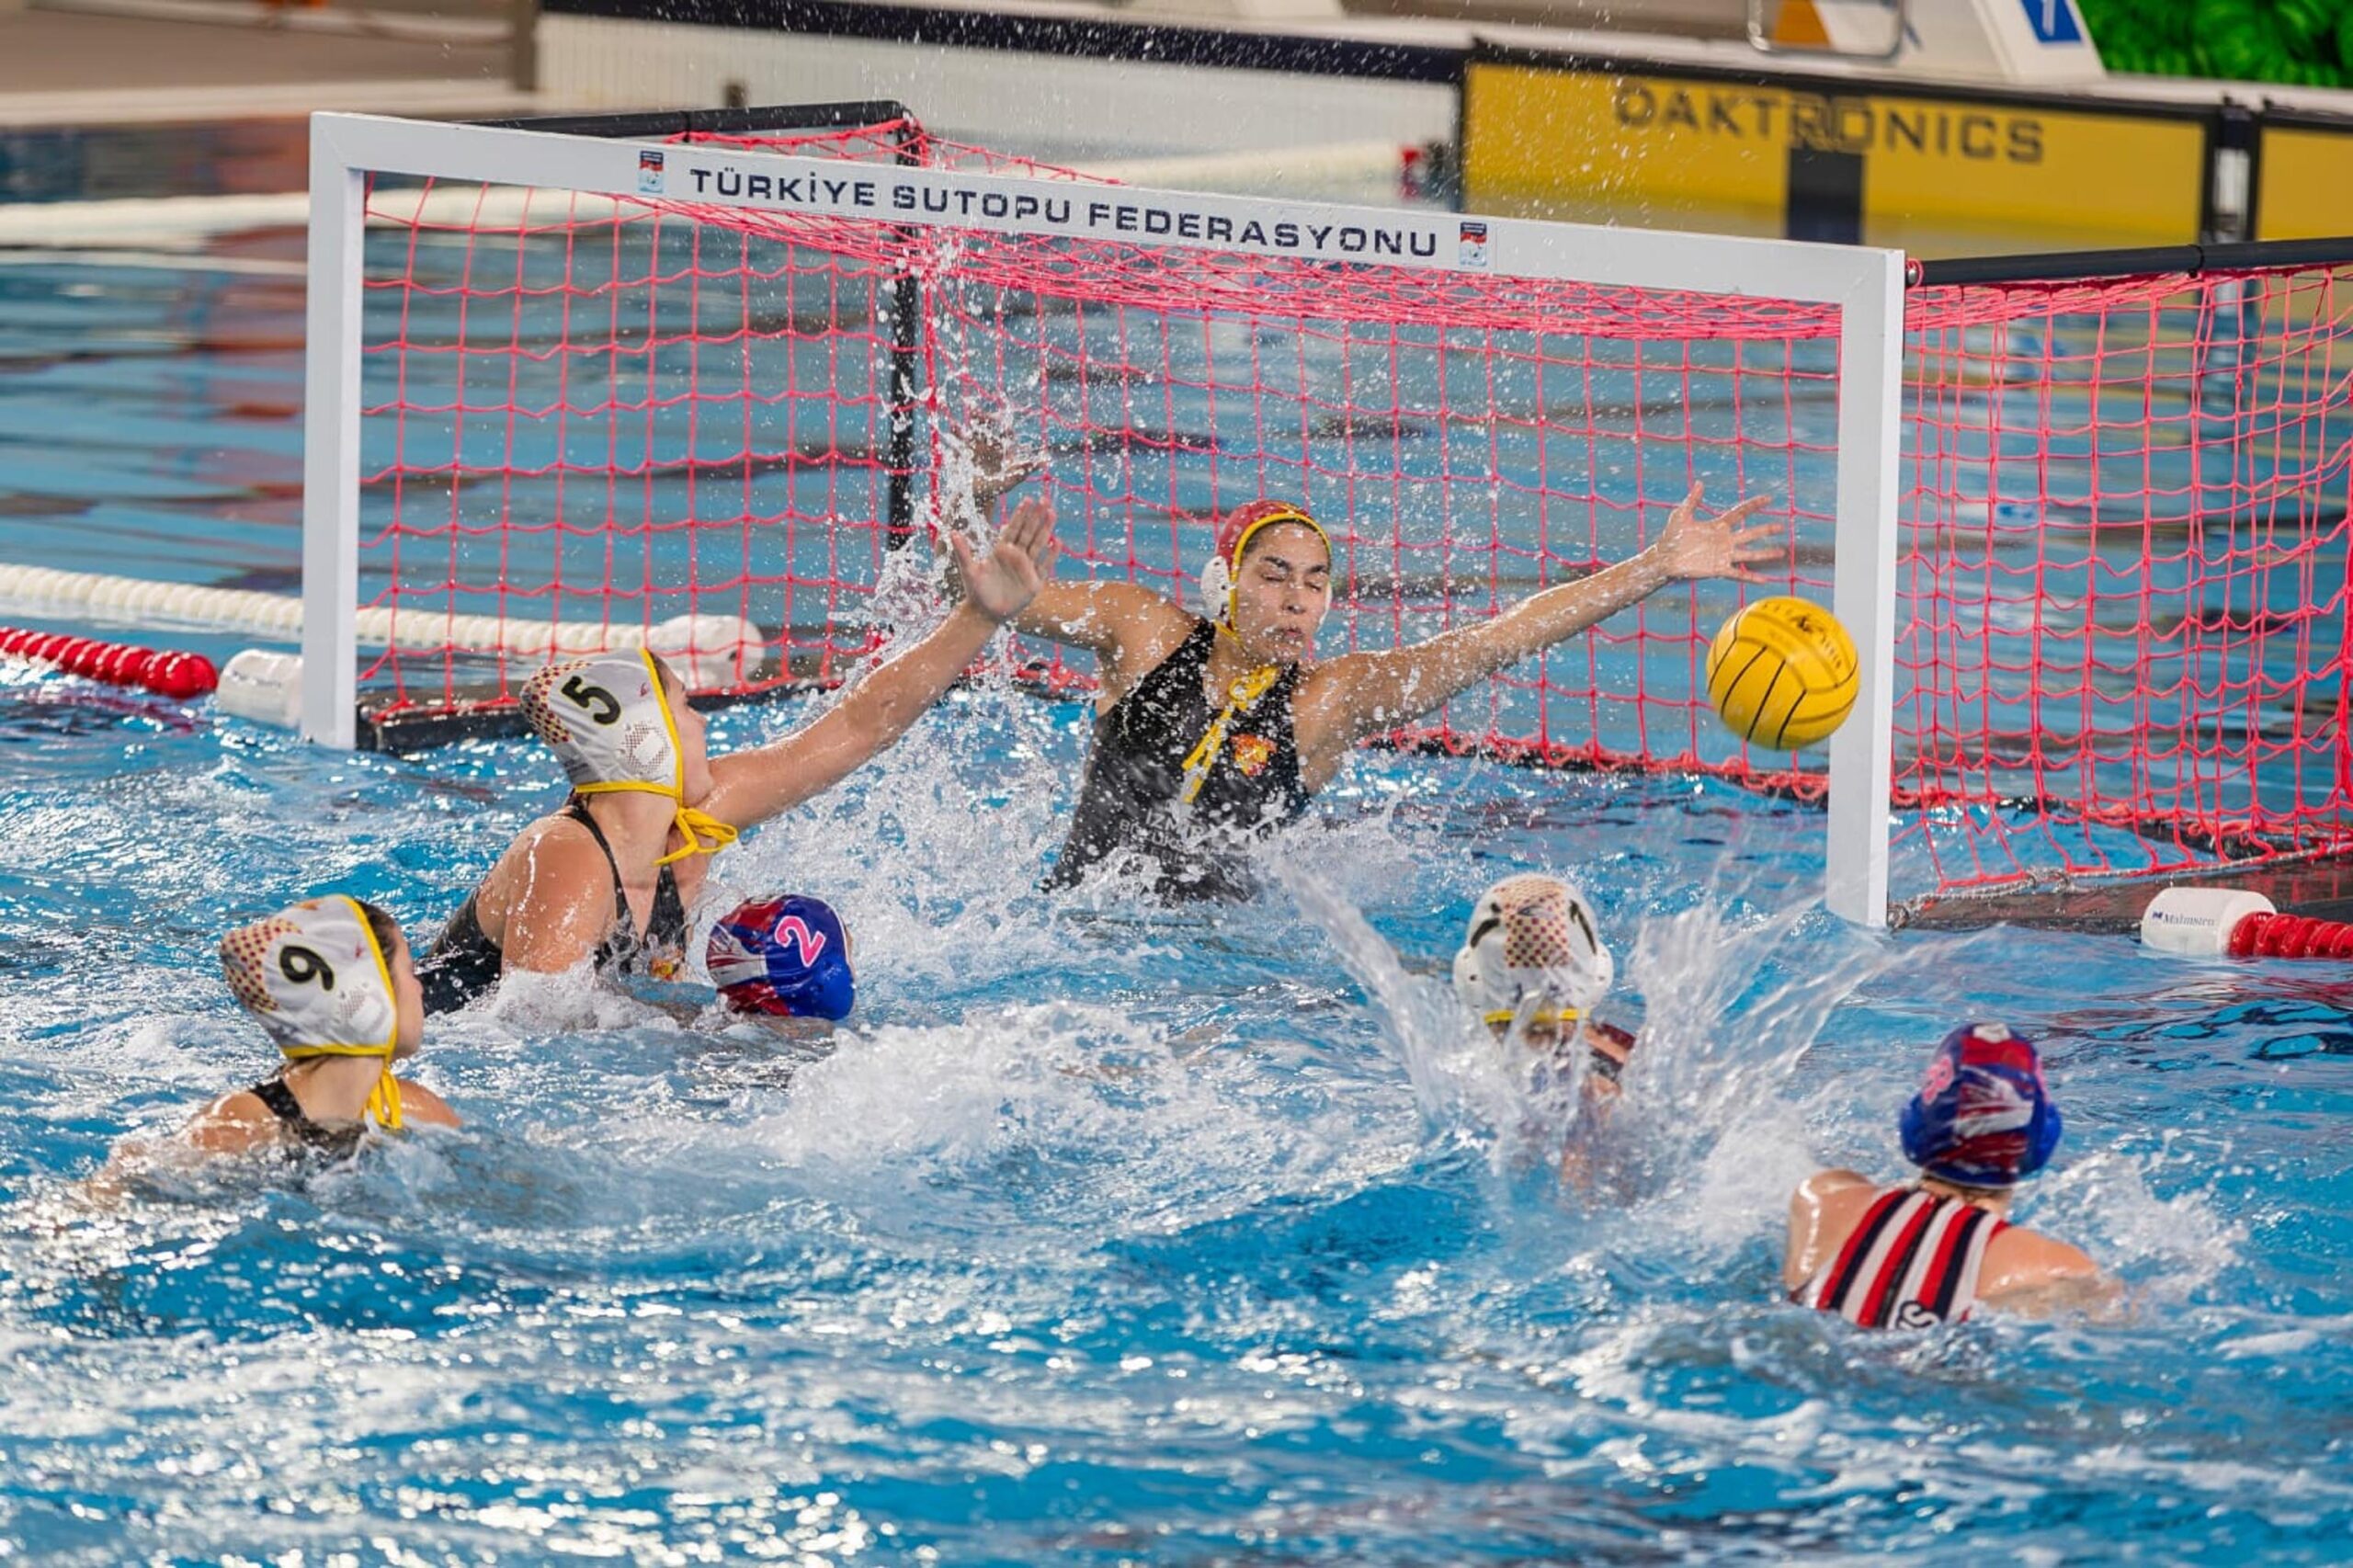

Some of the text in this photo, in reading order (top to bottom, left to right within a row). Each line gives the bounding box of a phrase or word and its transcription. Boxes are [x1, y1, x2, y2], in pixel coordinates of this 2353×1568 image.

[689, 166, 1437, 258] TÜRKİYE SUTOPU FEDERASYONU
[562, 676, 621, 725] 5
[774, 915, 826, 968] 2
[279, 945, 335, 992] 9
